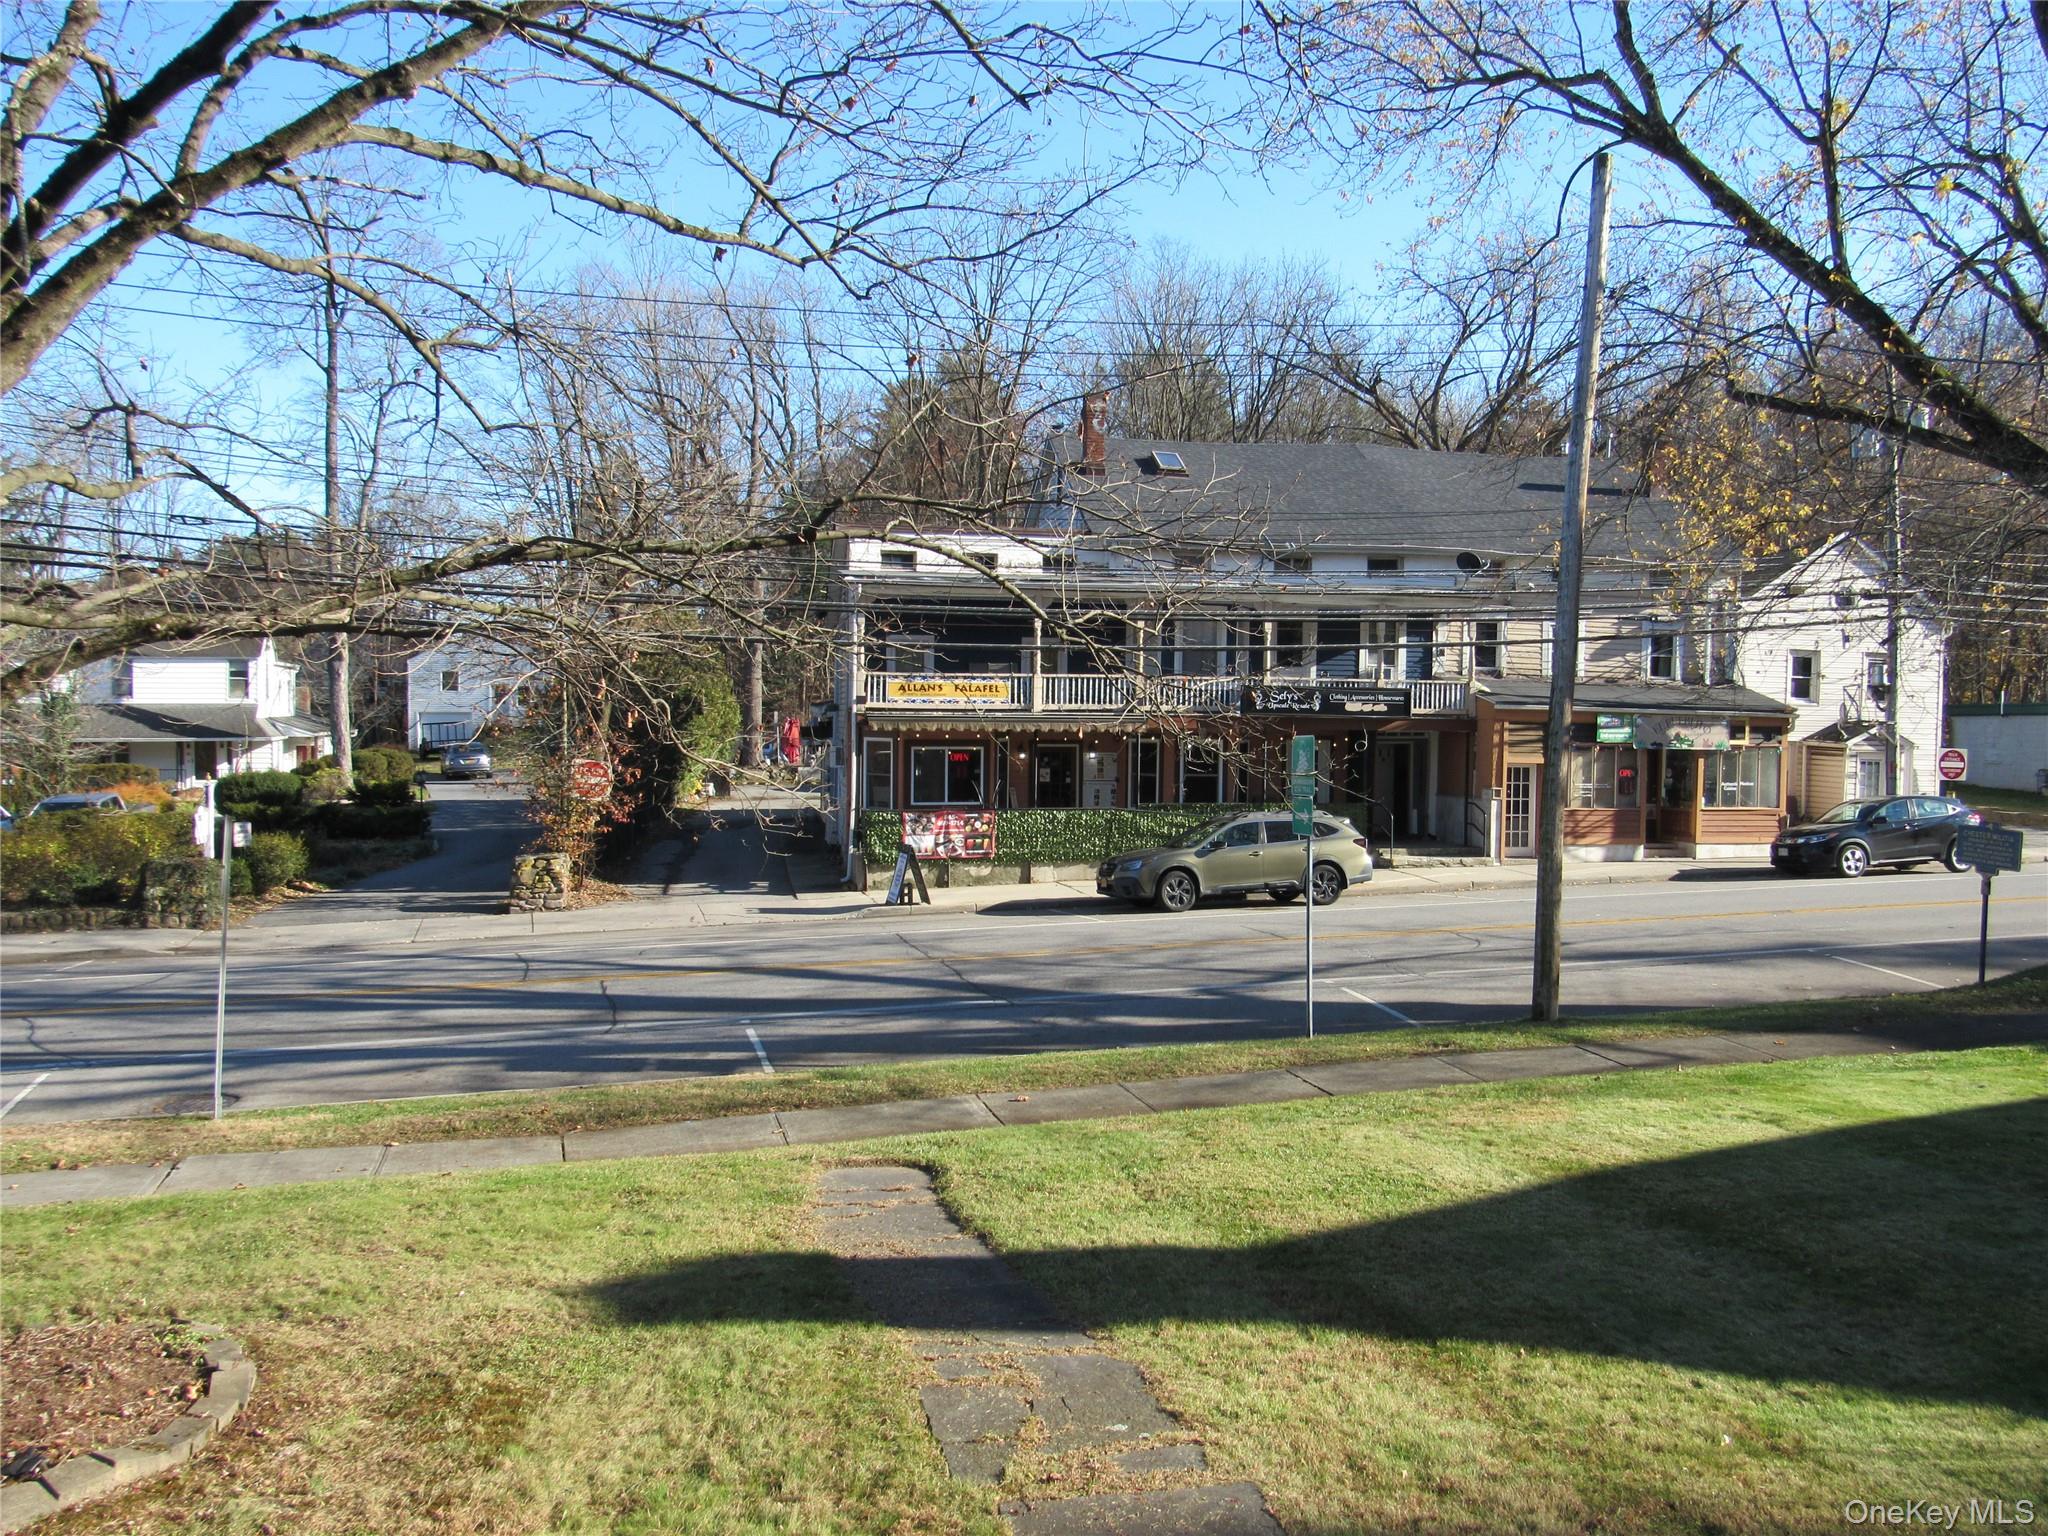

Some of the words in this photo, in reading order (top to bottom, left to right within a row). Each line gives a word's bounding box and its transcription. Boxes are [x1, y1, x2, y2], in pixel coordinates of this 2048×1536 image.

[898, 684, 943, 693] ALLAN'S
[954, 684, 1000, 693] FALAFEL
[1329, 693, 1347, 702] Clothing
[950, 753, 969, 761] OPEN
